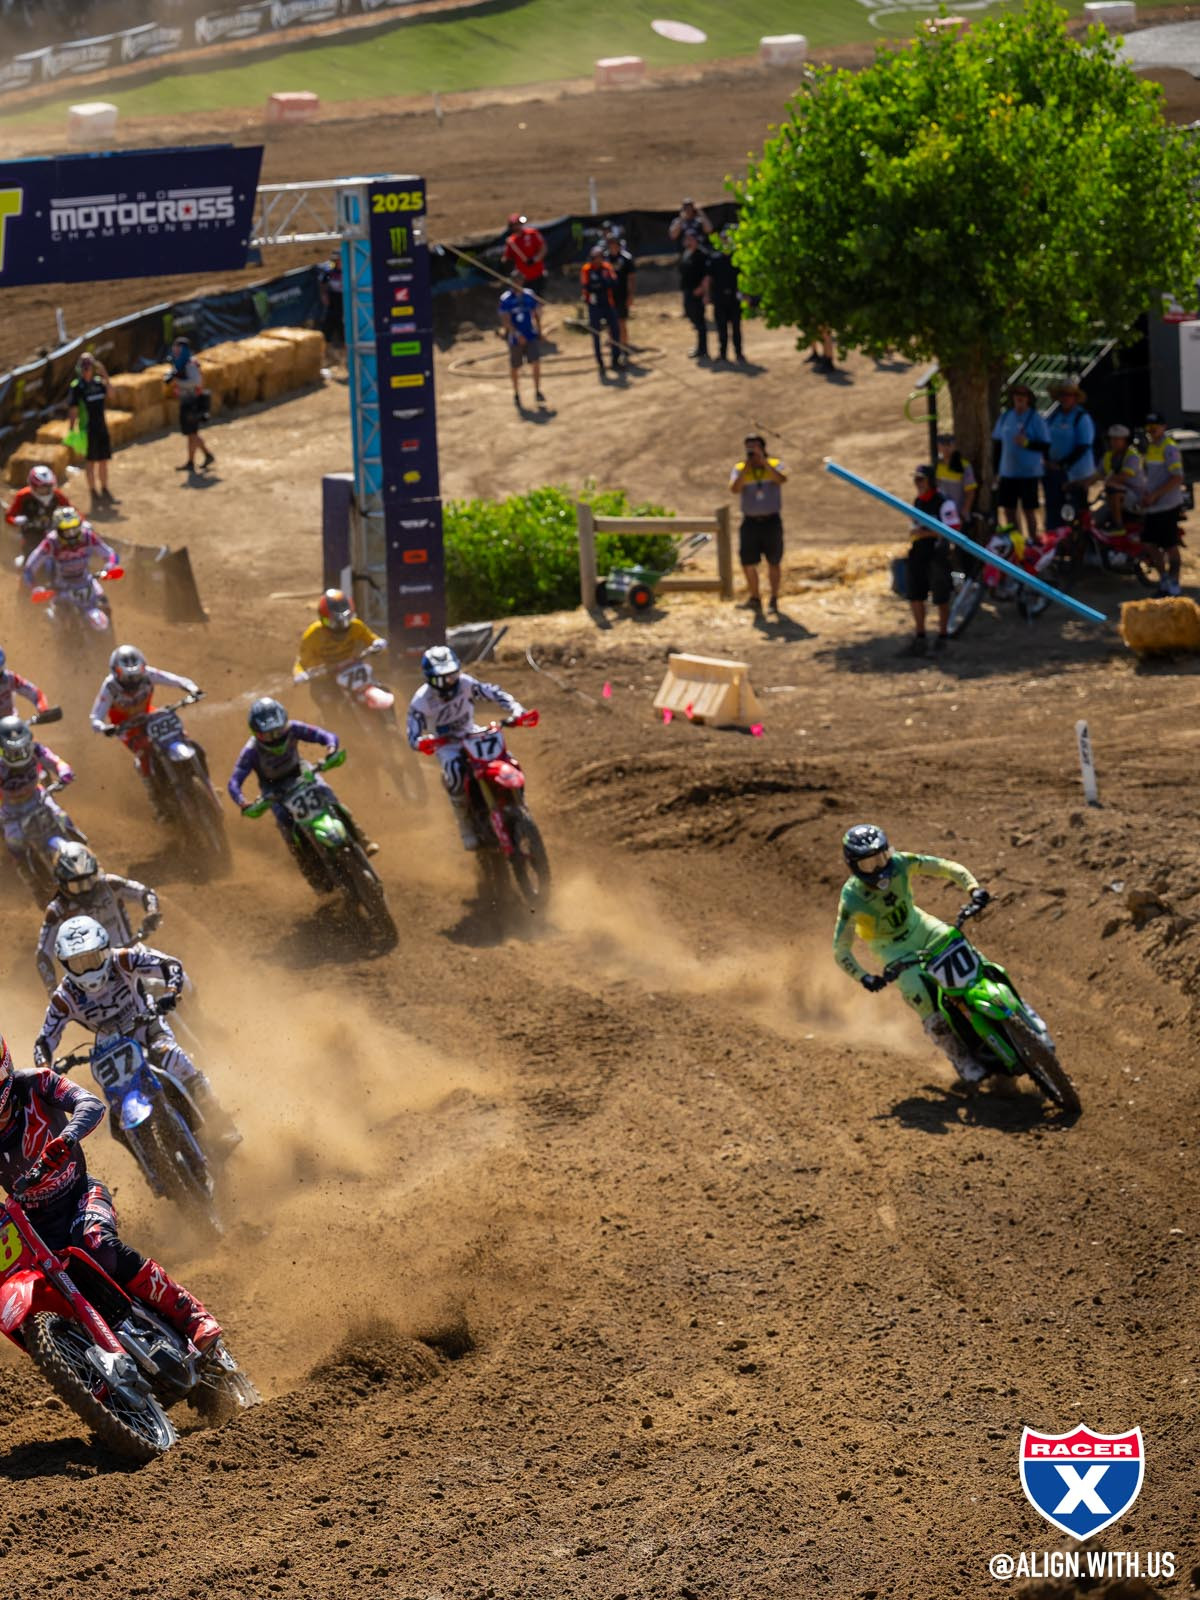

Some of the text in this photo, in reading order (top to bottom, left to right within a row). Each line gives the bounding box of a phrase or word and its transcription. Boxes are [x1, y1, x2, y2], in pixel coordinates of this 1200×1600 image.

[117, 189, 167, 202] PRO
[372, 192, 424, 214] 2025
[50, 197, 235, 232] MOTOCROSS
[51, 218, 236, 242] CHAMPIONSHIP
[476, 738, 499, 757] 17
[292, 790, 323, 817] 33
[933, 944, 975, 988] 70
[96, 1044, 134, 1086] 37
[84, 1305, 121, 1348] DUNLOP
